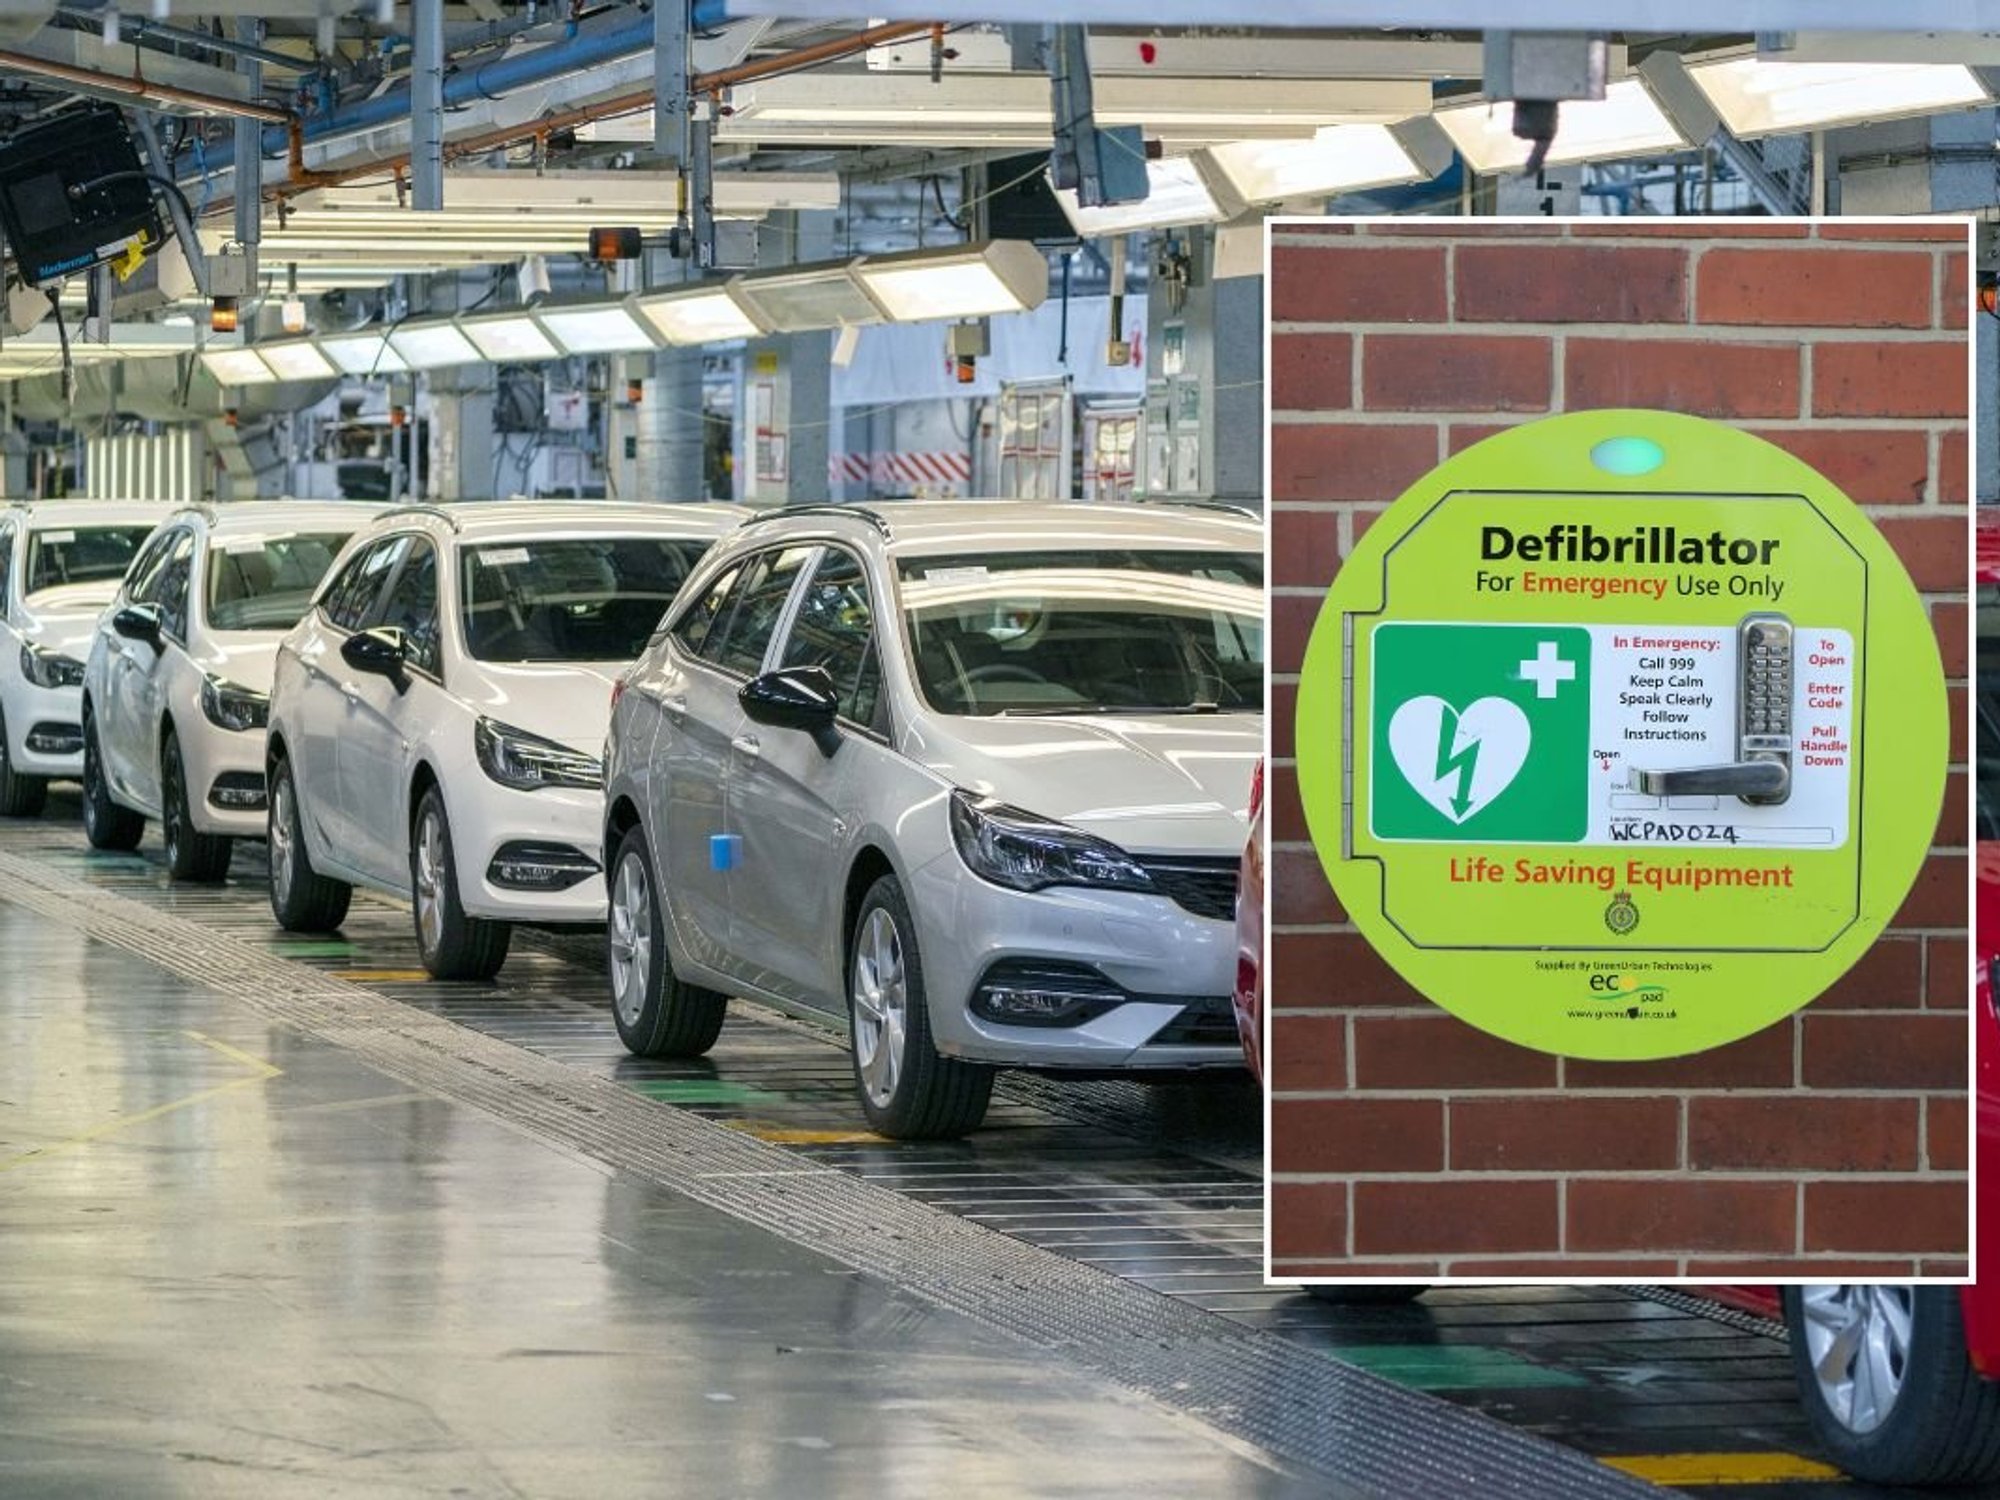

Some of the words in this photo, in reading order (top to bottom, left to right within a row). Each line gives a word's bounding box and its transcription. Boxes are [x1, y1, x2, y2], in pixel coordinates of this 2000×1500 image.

[1480, 525, 1780, 566] Defibrillator
[1476, 570, 1514, 592] For
[1523, 571, 1668, 599] Emergency
[1676, 575, 1720, 596] Use
[1728, 575, 1785, 602] Only
[1613, 635, 1628, 649] In
[1632, 636, 1721, 652] Emergency:
[1820, 640, 1834, 651] To
[1639, 657, 1664, 670] Call
[1669, 658, 1696, 670] 999
[1808, 654, 1845, 668] Open
[1630, 674, 1664, 690] Keep
[1668, 675, 1704, 688] Calm
[1808, 682, 1844, 694] Enter
[1619, 692, 1662, 708] Speak
[1665, 693, 1713, 708] Clearly
[1808, 697, 1842, 709] Code
[1643, 710, 1690, 723] Follow
[1624, 728, 1707, 741] Instructions
[1812, 726, 1837, 738] Pull
[1801, 740, 1848, 752] Handle
[1593, 749, 1621, 760] Open
[1804, 755, 1844, 766] Down
[1450, 857, 1504, 883] Life
[1515, 859, 1616, 890] Saving
[1626, 861, 1793, 891] Equipment
[1535, 960, 1576, 971] Supplied
[1652, 961, 1713, 972] Technologies
[1641, 991, 1664, 1003] pad
